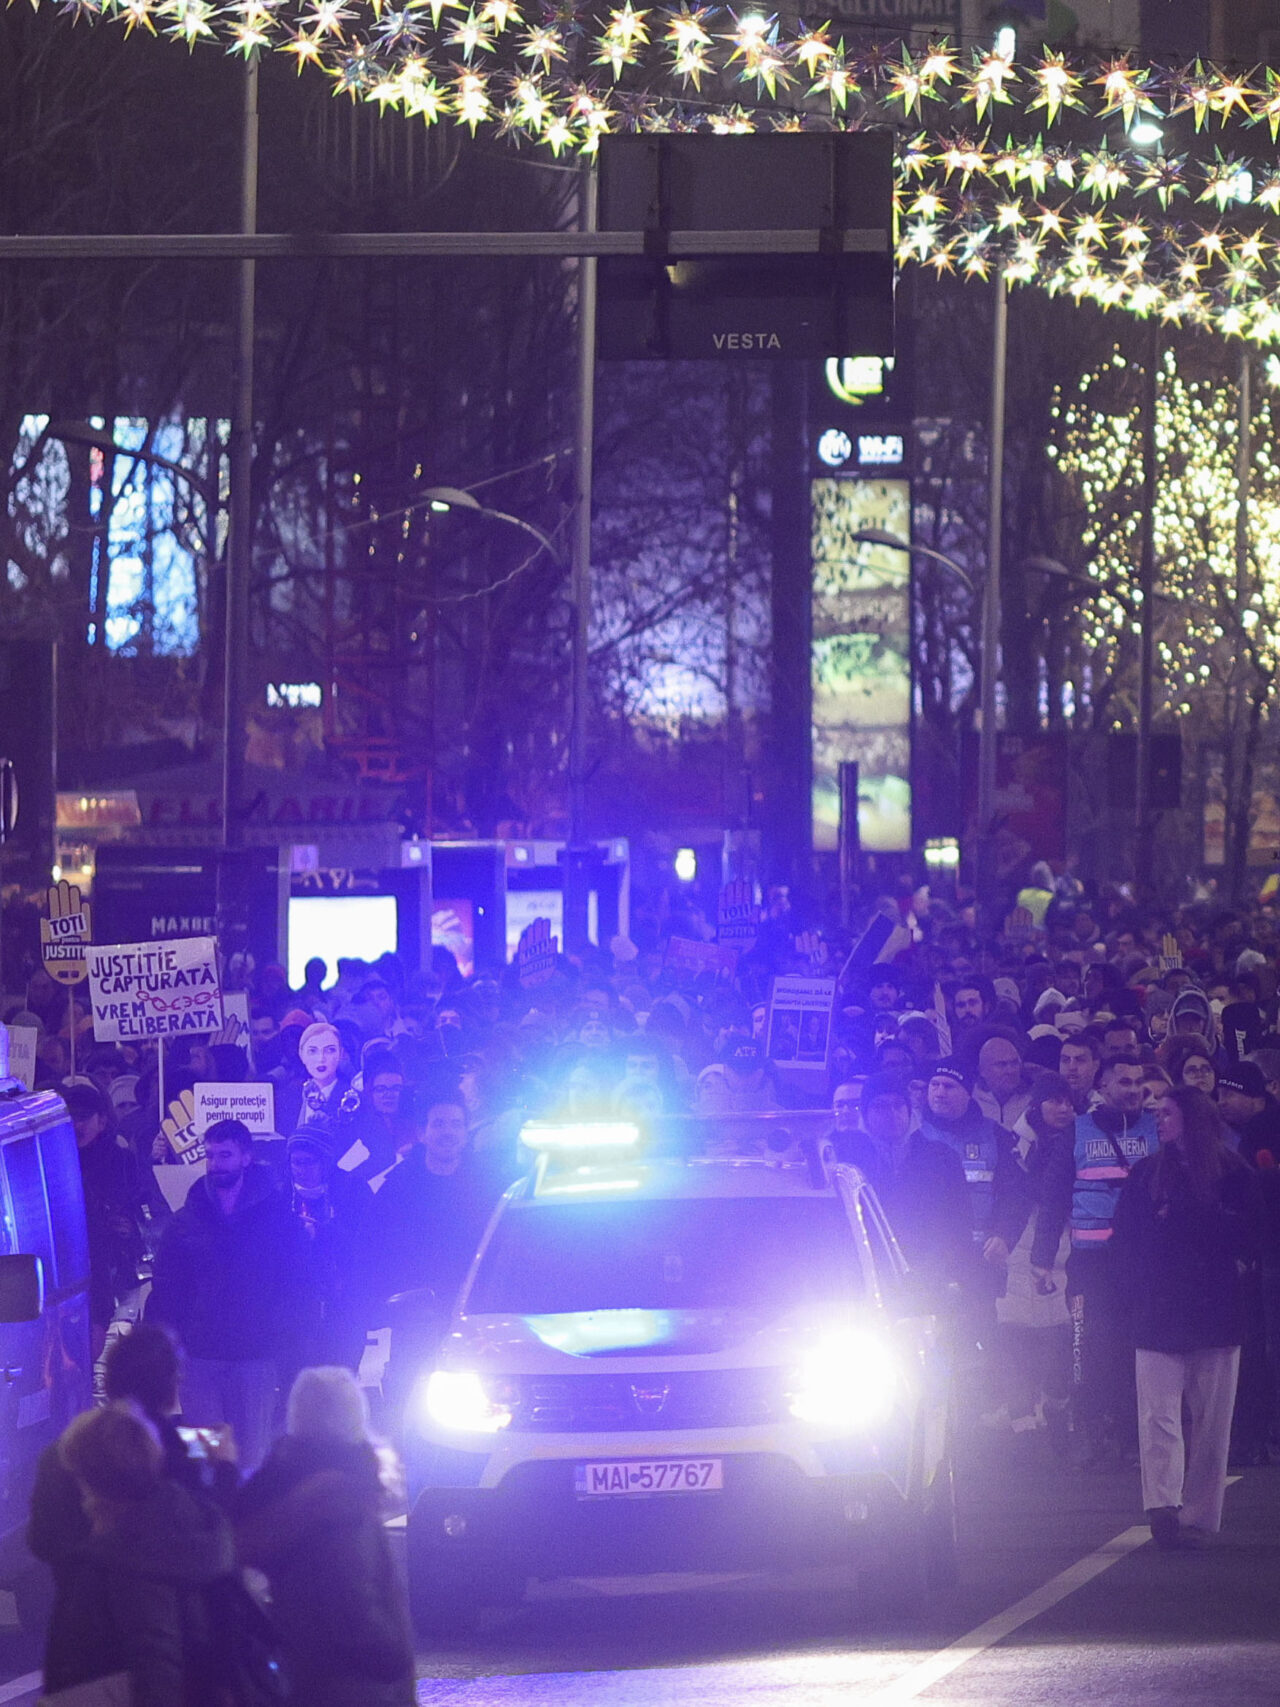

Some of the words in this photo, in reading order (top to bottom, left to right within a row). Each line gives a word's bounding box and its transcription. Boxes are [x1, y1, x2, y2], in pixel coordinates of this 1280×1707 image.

[712, 333, 781, 350] VESTA
[100, 963, 216, 994] CAPTURATĂ
[95, 1001, 146, 1020] VREM
[118, 1004, 219, 1035] ELIBERATĂ
[200, 1095, 228, 1108] Asigur
[206, 1111, 233, 1122] pentru
[1086, 1139, 1147, 1158] JANDAMERIA
[592, 1466, 629, 1491] MAI
[639, 1463, 714, 1489] 57767
